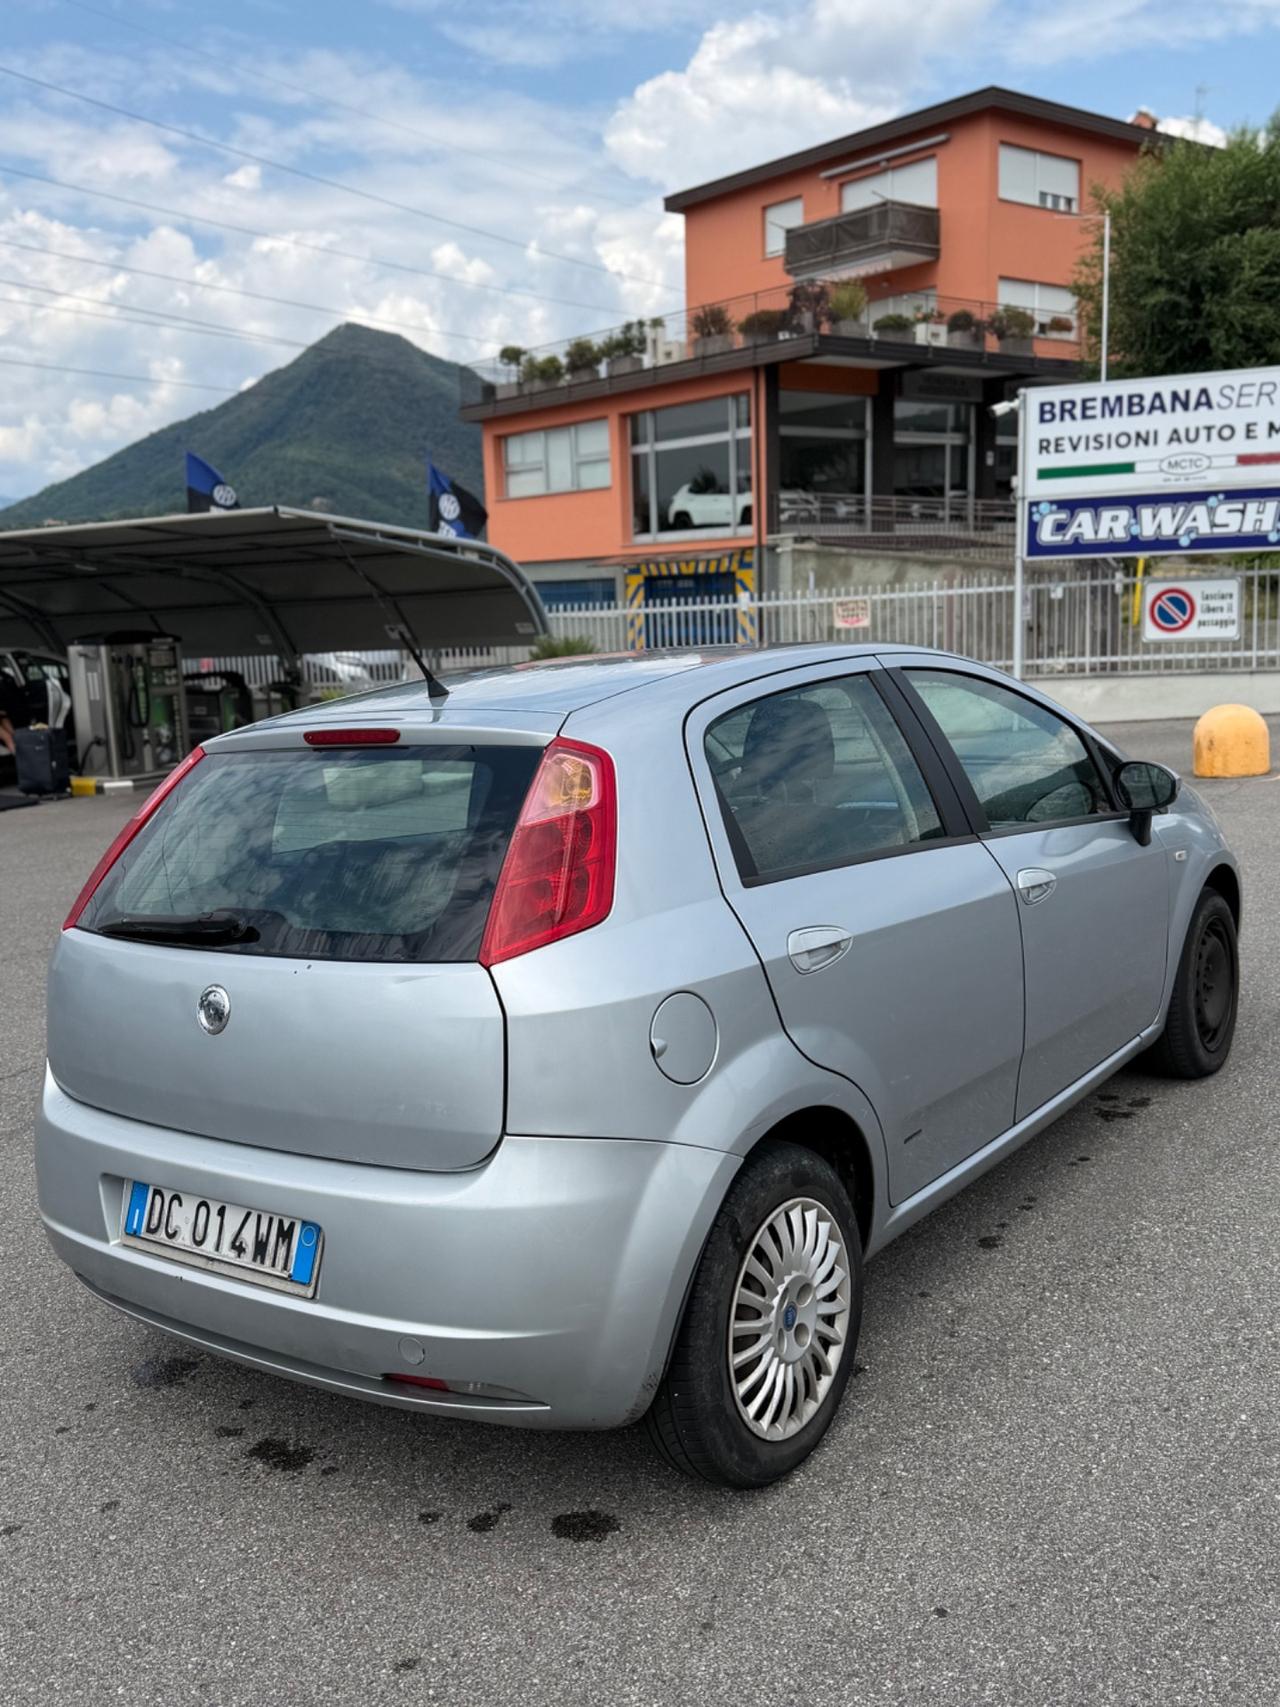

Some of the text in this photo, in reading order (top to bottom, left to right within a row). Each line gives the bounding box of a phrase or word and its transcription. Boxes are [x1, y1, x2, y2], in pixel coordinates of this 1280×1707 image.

[1038, 380, 1280, 424] BREMBANASER
[1038, 429, 1159, 455] REVISIONI
[1167, 424, 1236, 445] AUTO
[1245, 421, 1258, 440] E
[1167, 457, 1203, 470] MCTC
[1038, 500, 1279, 543] CAR WASH
